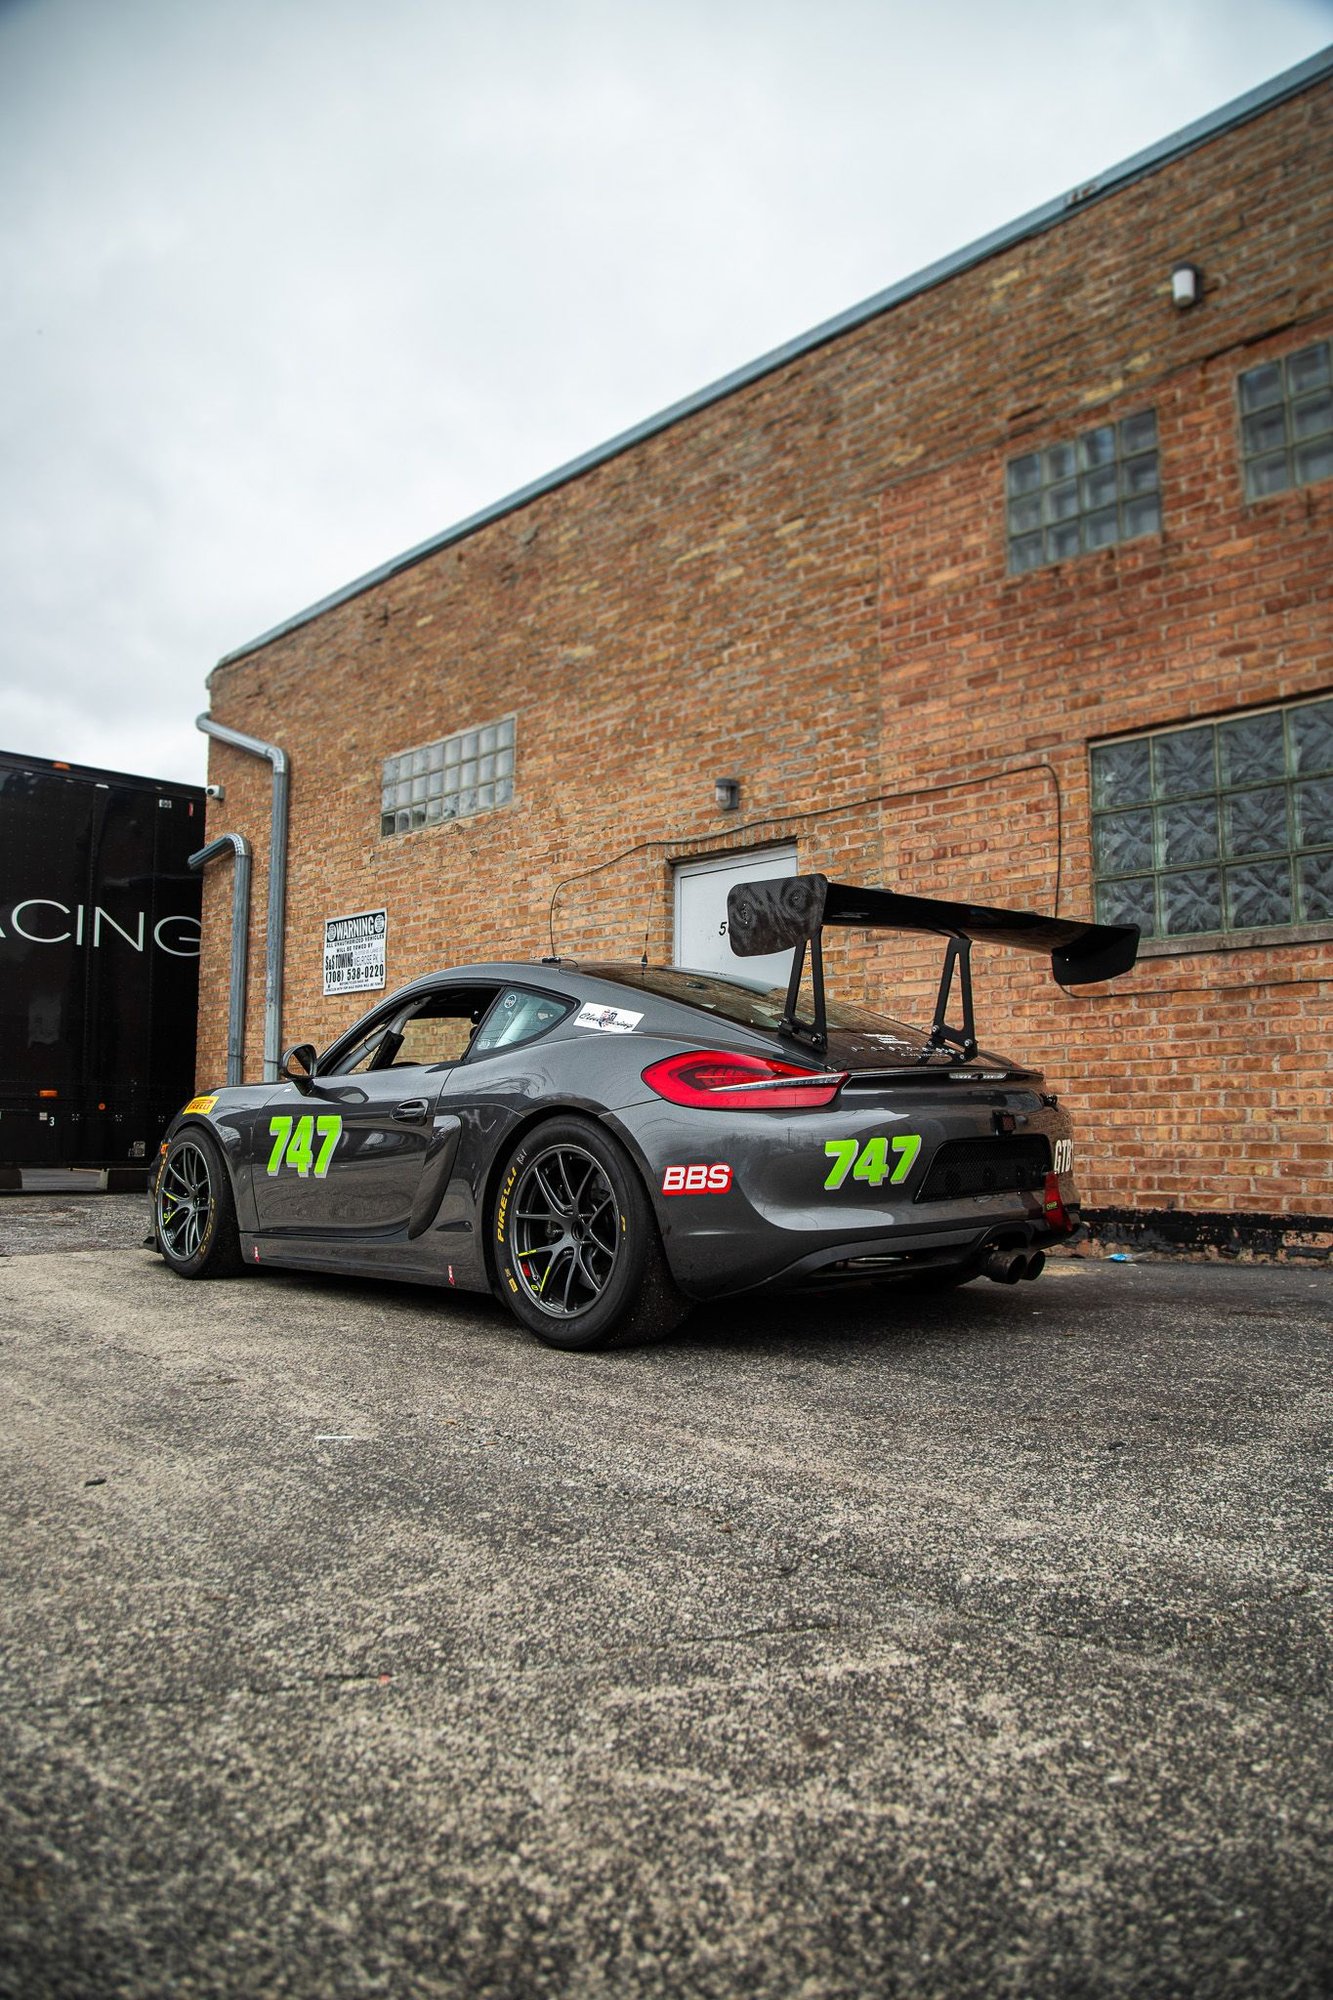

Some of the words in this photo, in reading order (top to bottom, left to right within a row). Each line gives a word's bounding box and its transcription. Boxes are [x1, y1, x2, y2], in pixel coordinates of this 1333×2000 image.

[0, 898, 202, 957] CING
[336, 916, 374, 940] WARNING
[334, 937, 364, 947] UNAUTHORIZED
[325, 969, 344, 983] (708)
[347, 964, 384, 981] 538-0220
[335, 952, 354, 969] TOWING
[267, 1115, 343, 1179] 747
[823, 1134, 922, 1190] 747
[662, 1163, 731, 1191] BBS
[497, 1166, 517, 1243] PIRELLI
